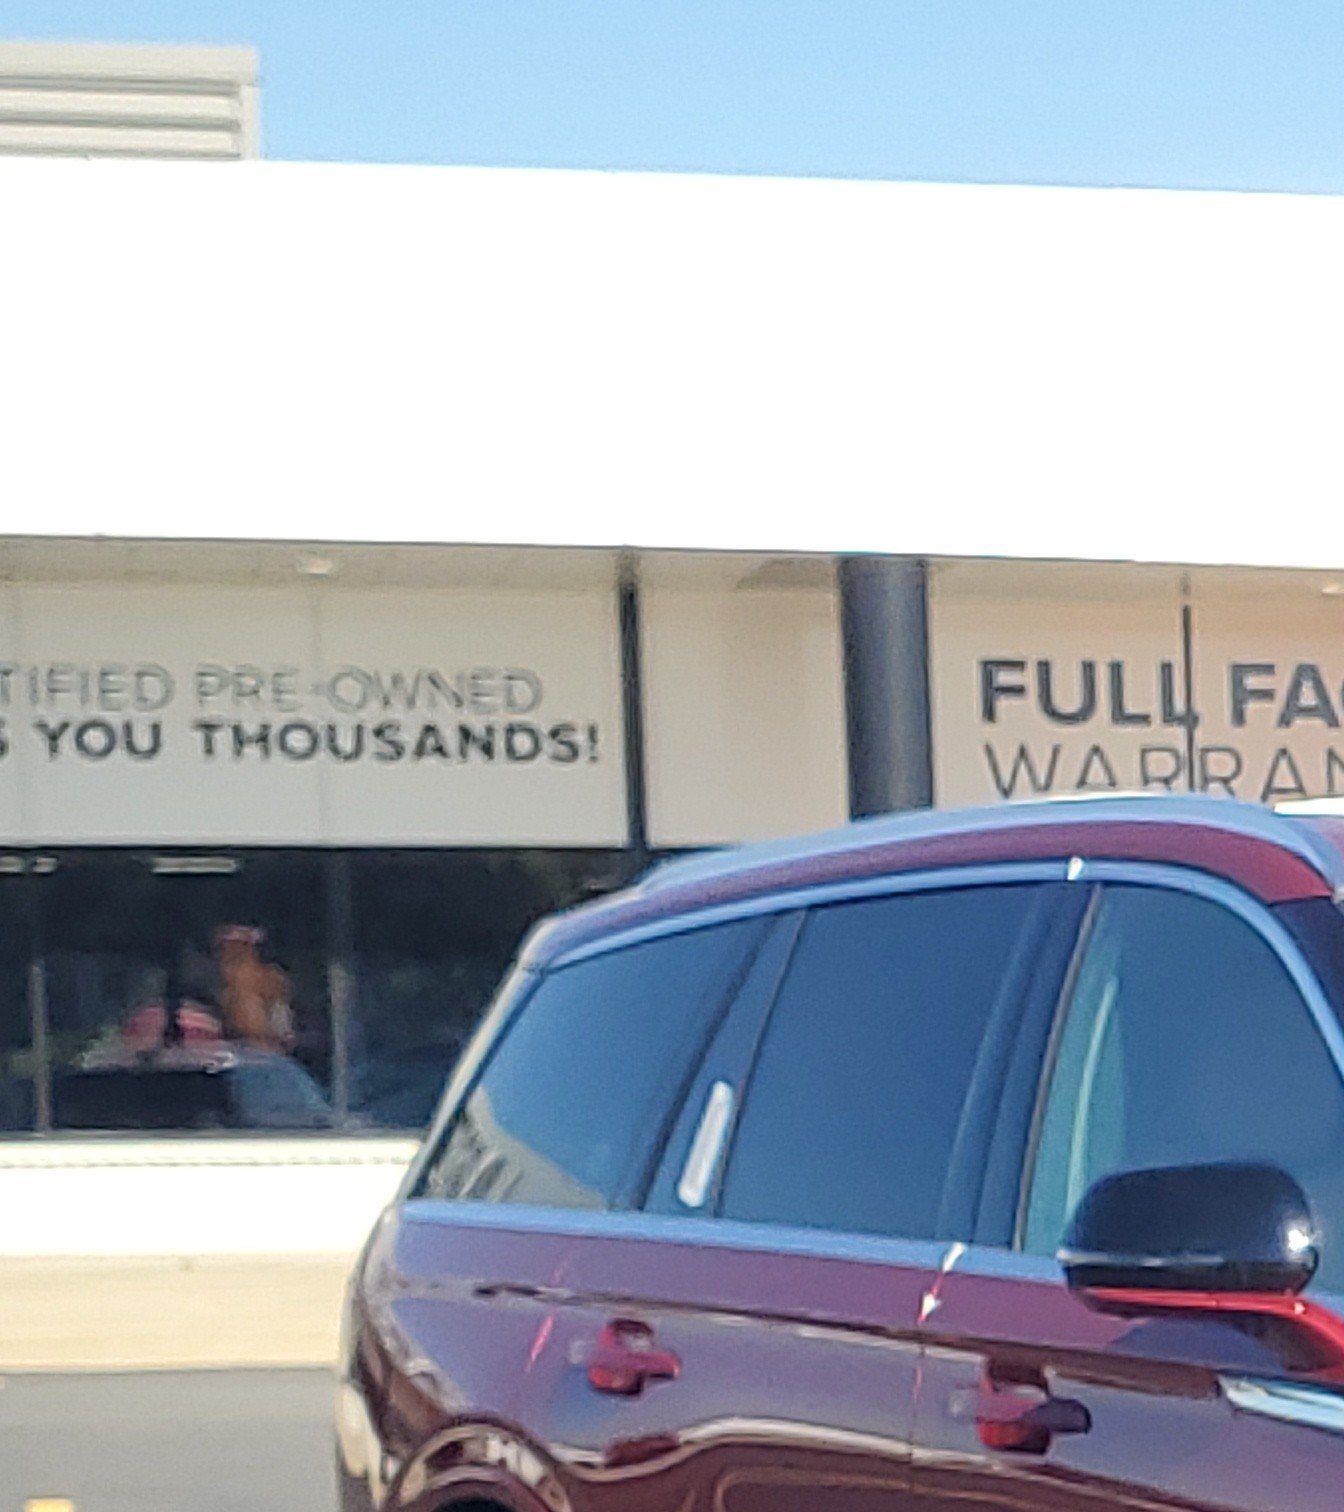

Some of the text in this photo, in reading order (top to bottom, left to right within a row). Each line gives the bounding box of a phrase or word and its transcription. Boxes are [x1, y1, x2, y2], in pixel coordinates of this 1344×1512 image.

[194, 664, 543, 714] PRE-OWNED
[980, 659, 1198, 726] FULL
[34, 719, 162, 758] YOU
[193, 720, 599, 763] THOUSANDS!
